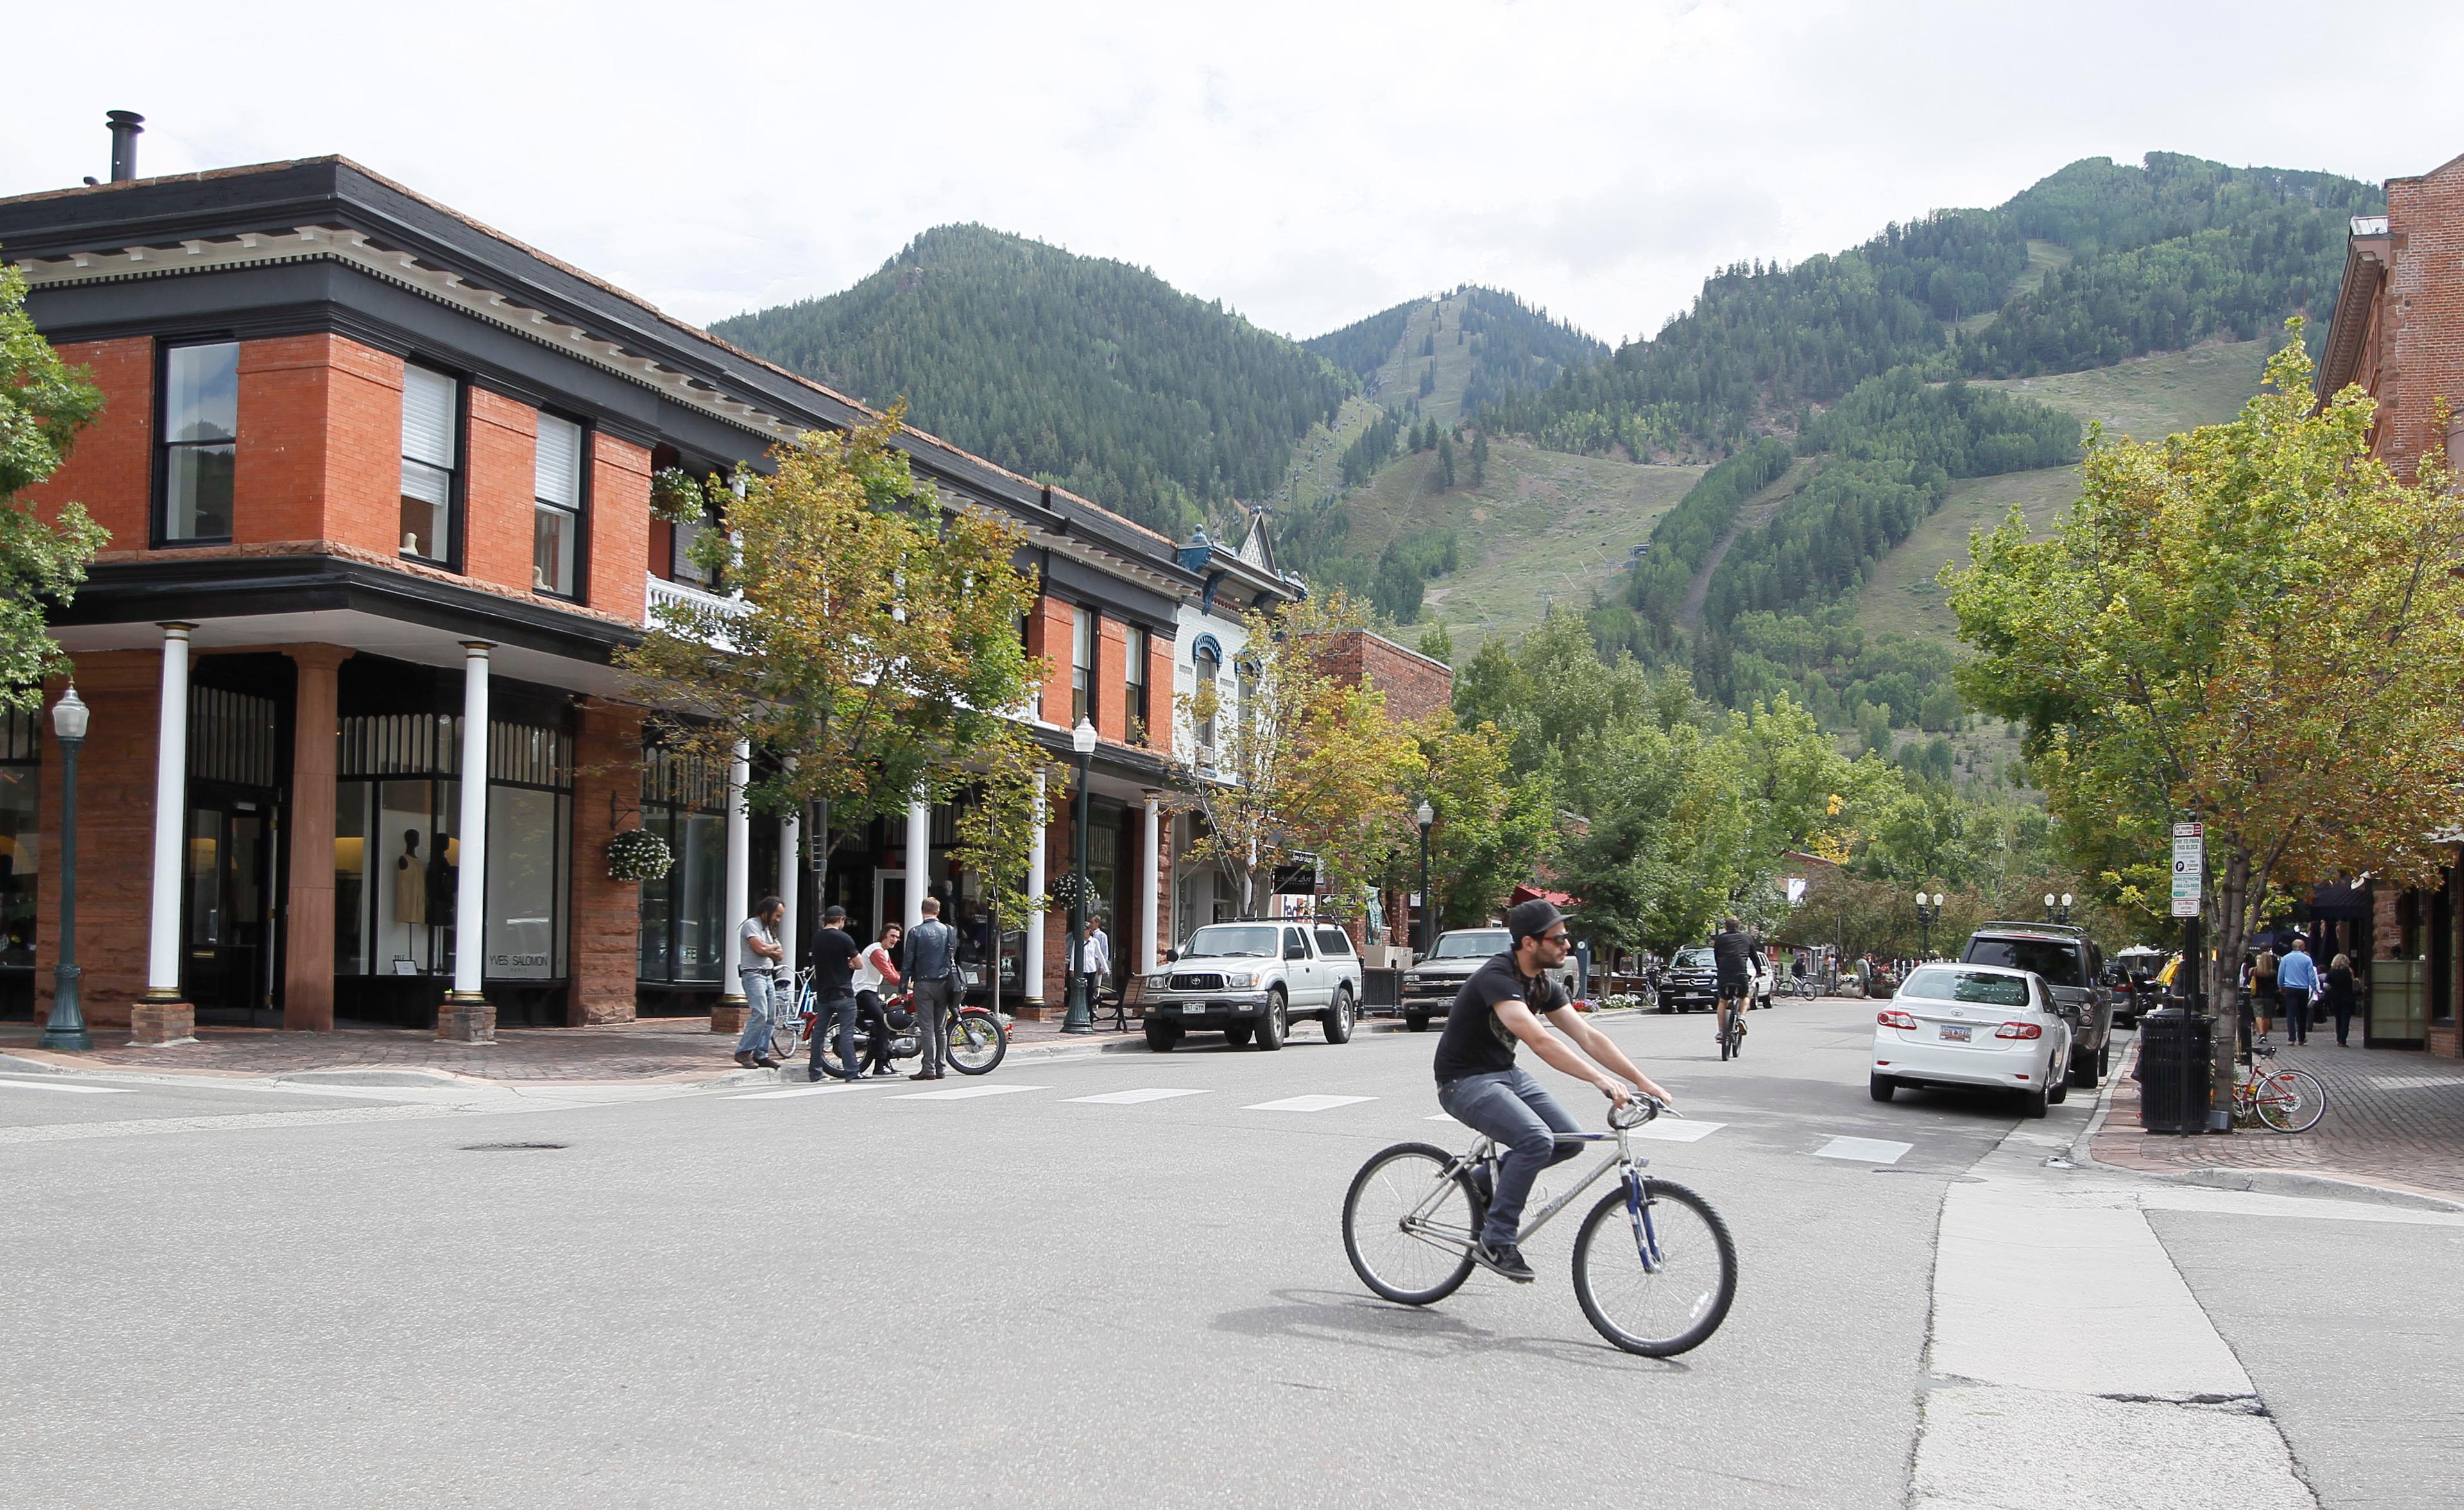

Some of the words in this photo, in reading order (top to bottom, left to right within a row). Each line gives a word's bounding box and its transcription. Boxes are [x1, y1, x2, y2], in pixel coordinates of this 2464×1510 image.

[1297, 874, 1312, 882] Art
[489, 955, 509, 966] YVES
[513, 956, 548, 966] SALOMON
